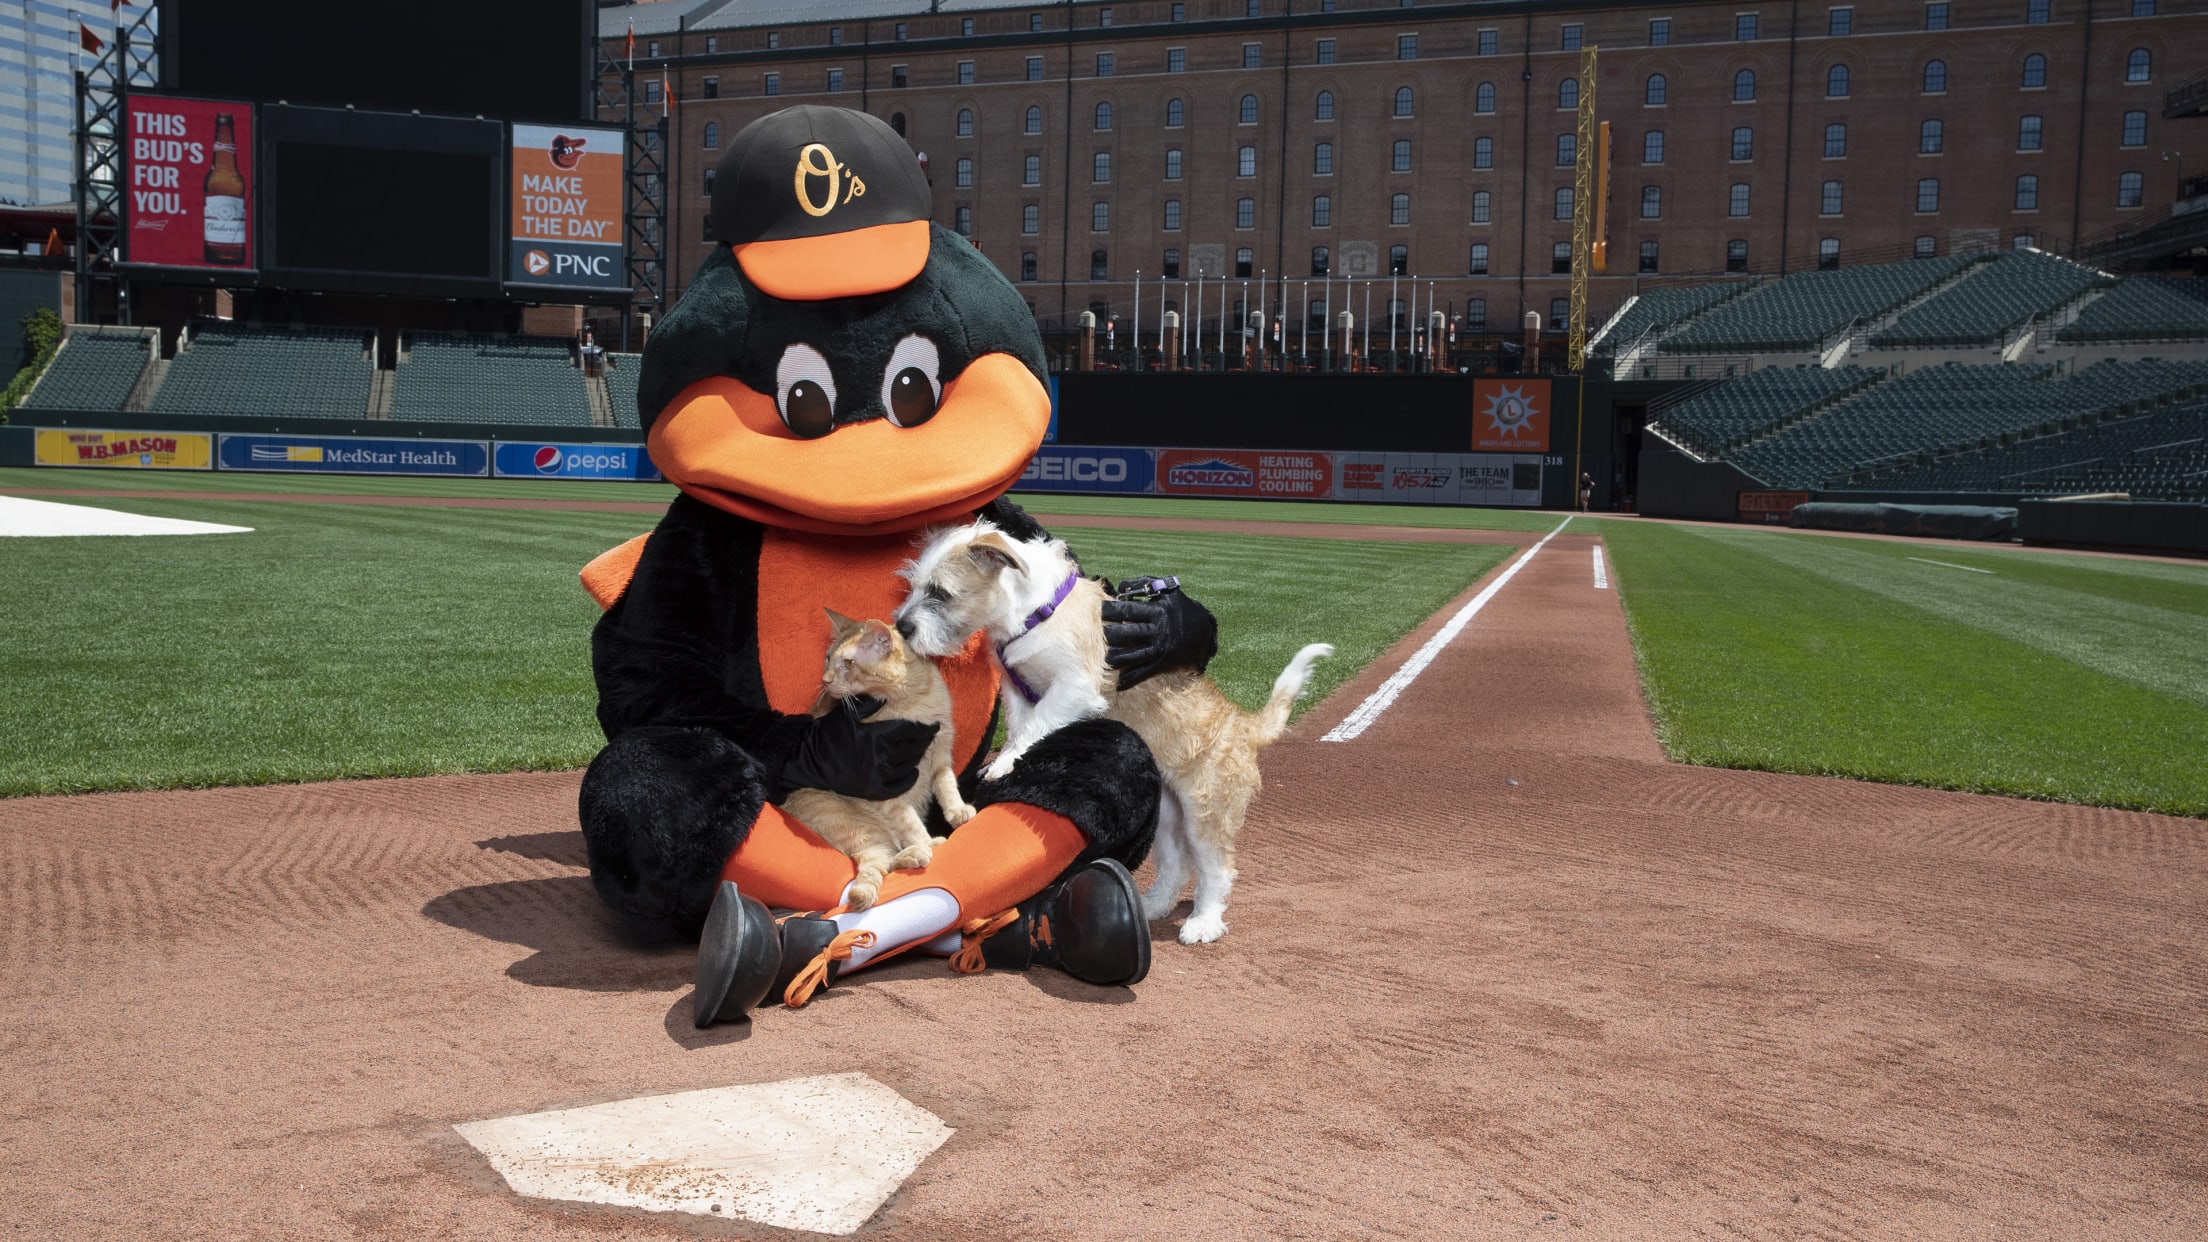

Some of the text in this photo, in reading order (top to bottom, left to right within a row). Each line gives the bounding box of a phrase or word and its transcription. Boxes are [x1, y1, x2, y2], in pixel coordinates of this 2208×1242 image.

[132, 111, 186, 137] THIS
[134, 138, 204, 164] BUD'S
[134, 165, 180, 188] FOR
[522, 174, 583, 195] MAKE
[794, 143, 866, 217] O's
[134, 191, 187, 215] YOU.
[522, 195, 588, 216] TODAY
[521, 216, 562, 235] THE
[554, 254, 611, 277] PNC
[326, 448, 457, 466] MedStar Health
[567, 452, 626, 472] pepsi
[1258, 455, 1314, 468] HEATING
[1544, 456, 1564, 466] 318
[1020, 456, 1128, 482] GEICO
[1170, 469, 1251, 486] HORIZON
[1258, 468, 1323, 481] PLUMBING
[1459, 466, 1509, 481] THE TEAM
[1258, 480, 1314, 493] COOLING
